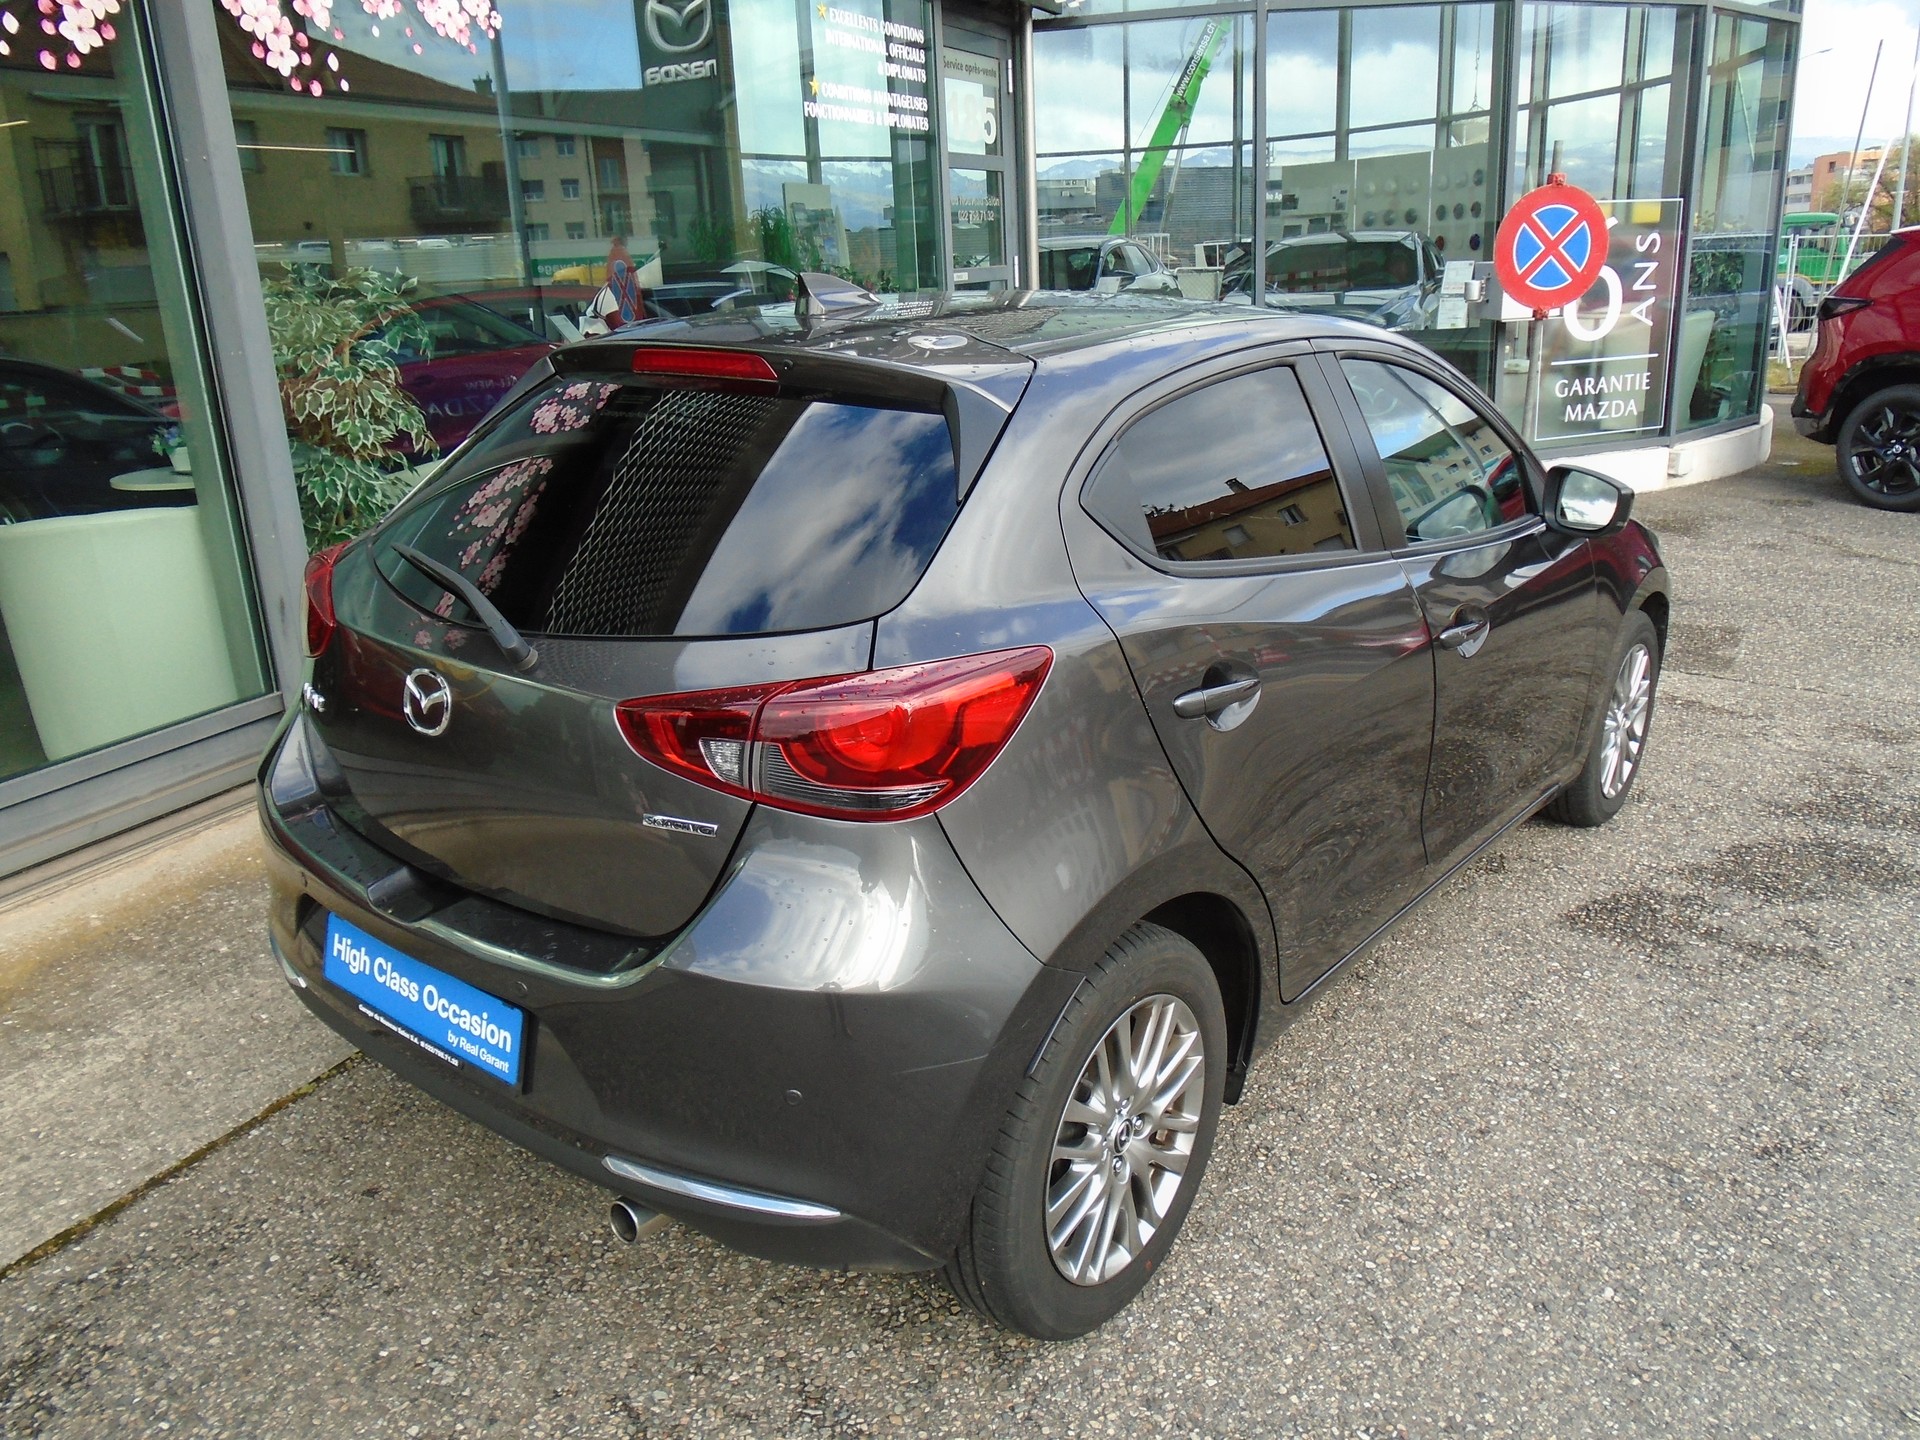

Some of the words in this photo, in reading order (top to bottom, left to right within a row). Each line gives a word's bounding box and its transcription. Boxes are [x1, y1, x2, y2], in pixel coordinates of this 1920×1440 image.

[880, 20, 924, 44] CONDITIONS
[825, 28, 888, 56] INTERNATIONAL
[889, 42, 925, 64] OFFICIALS
[885, 62, 926, 83] DIPLOMATS
[943, 55, 964, 72] Service
[1176, 22, 1216, 97] www.consensa.ch
[872, 90, 928, 111] AVANTAGEUSES
[883, 112, 929, 131] DIPLOMATES
[1629, 232, 1661, 327] ANS
[1554, 371, 1652, 399] GARANTIE
[1564, 398, 1638, 423] MAZDA
[333, 933, 371, 976] High
[373, 957, 420, 1003] Class
[422, 984, 512, 1053] Occasion
[447, 1030, 460, 1048] by
[459, 1037, 480, 1057] Real
[479, 1047, 510, 1074] Garant
